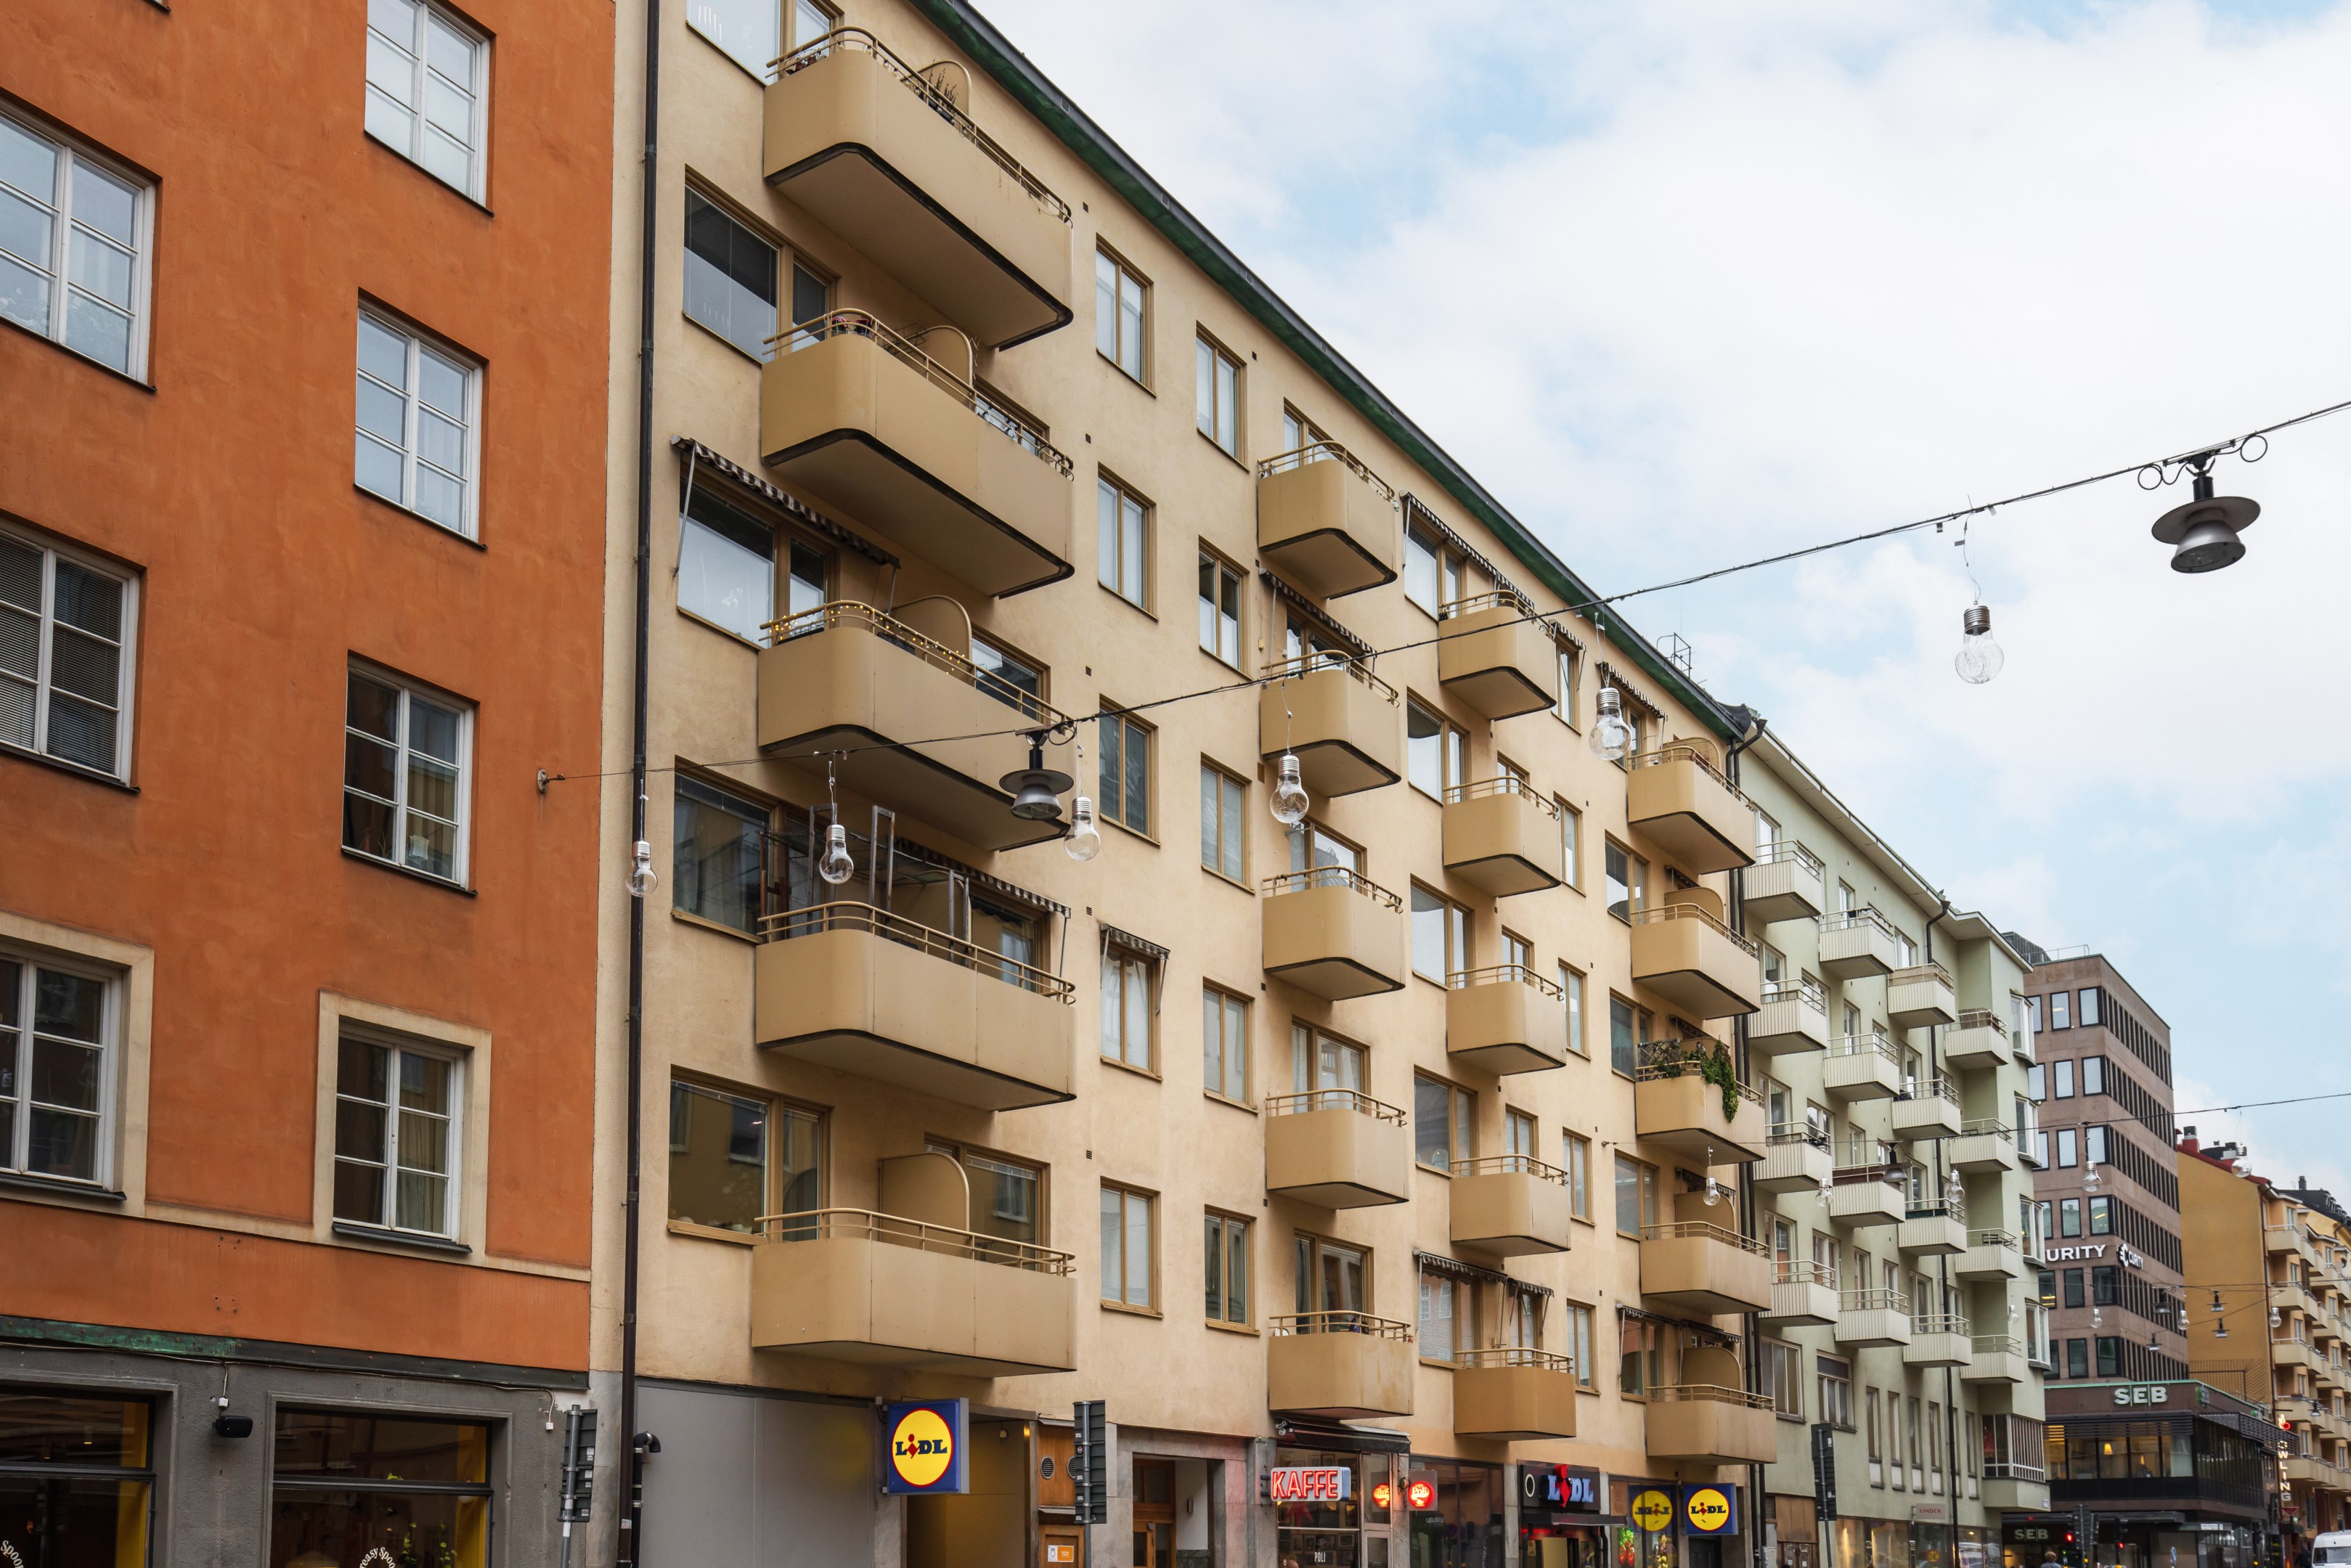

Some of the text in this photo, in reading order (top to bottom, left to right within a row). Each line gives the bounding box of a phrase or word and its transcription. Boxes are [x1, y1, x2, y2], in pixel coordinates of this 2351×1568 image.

[2114, 1387, 2168, 1405] SEB
[2278, 1440, 2291, 1501] OWLING
[1271, 1470, 1338, 1499] KAFFE
[2014, 1528, 2049, 1540] SEB
[1314, 1552, 1326, 1562] POLI
